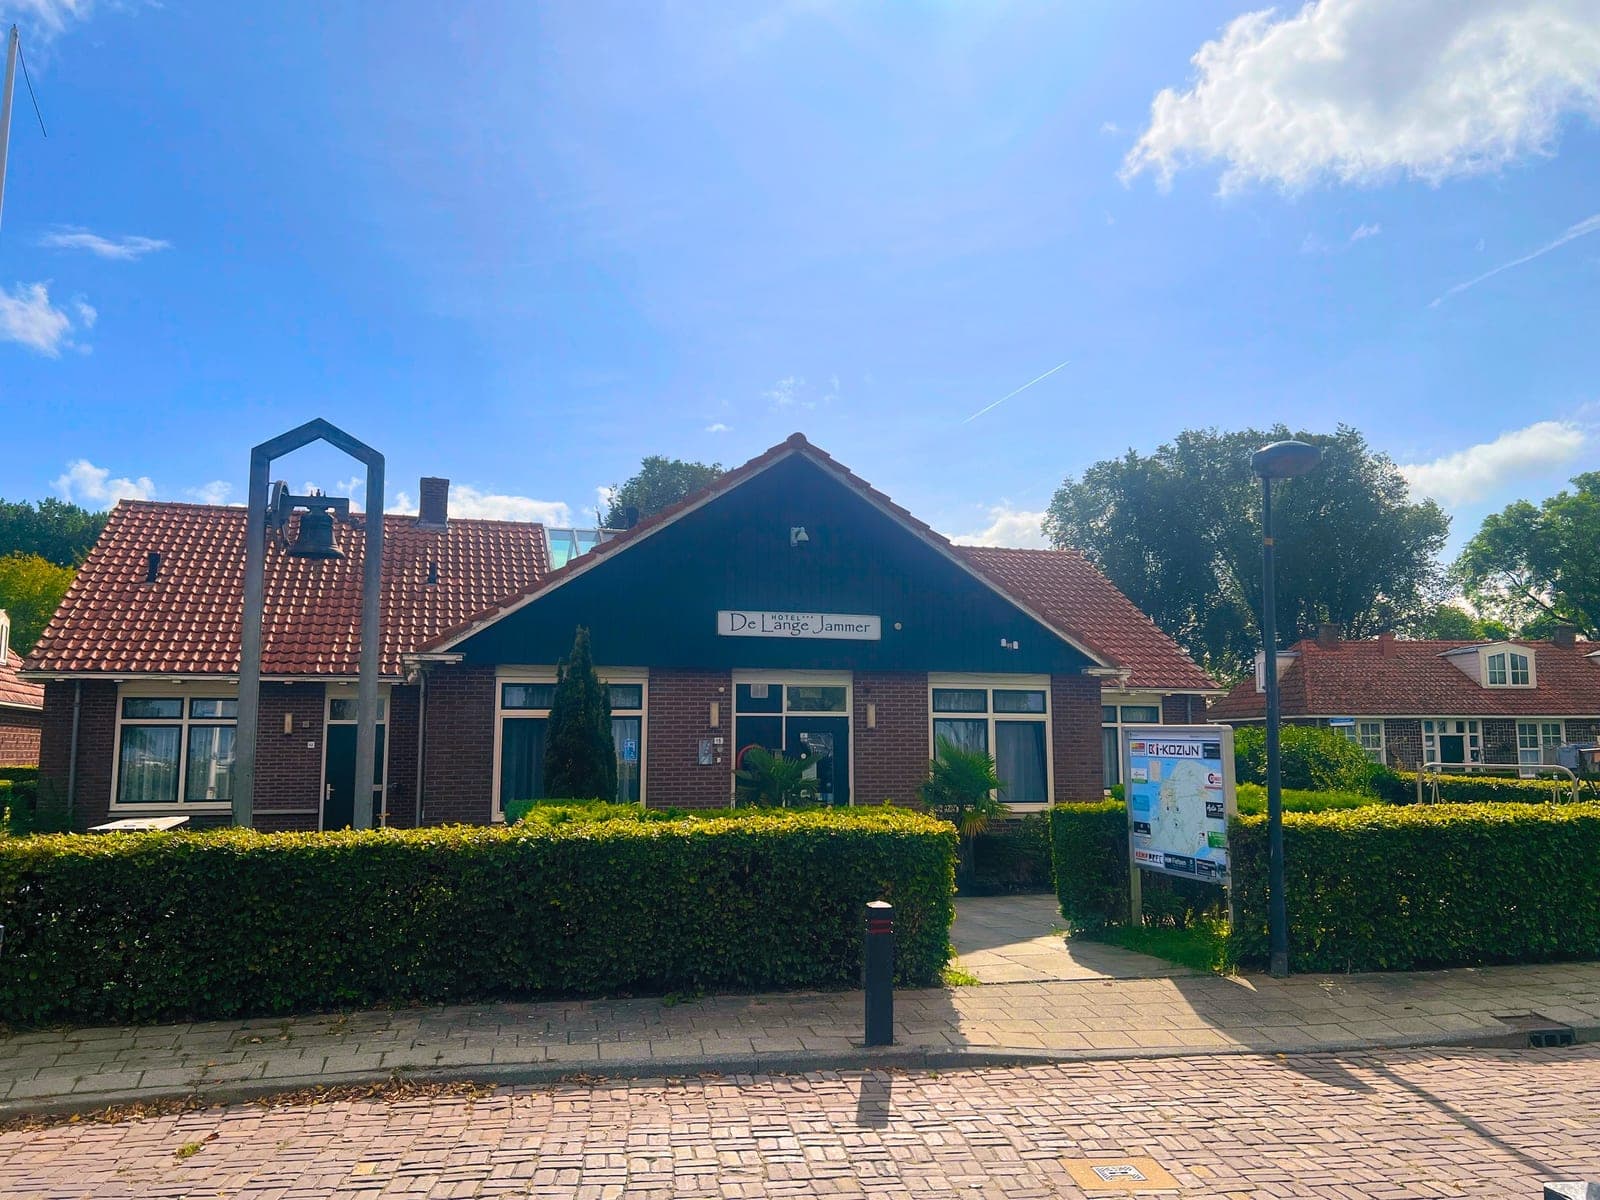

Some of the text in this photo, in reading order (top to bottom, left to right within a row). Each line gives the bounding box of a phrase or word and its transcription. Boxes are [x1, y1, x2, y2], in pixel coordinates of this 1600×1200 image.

[730, 613, 871, 636] De Lange Jammer
